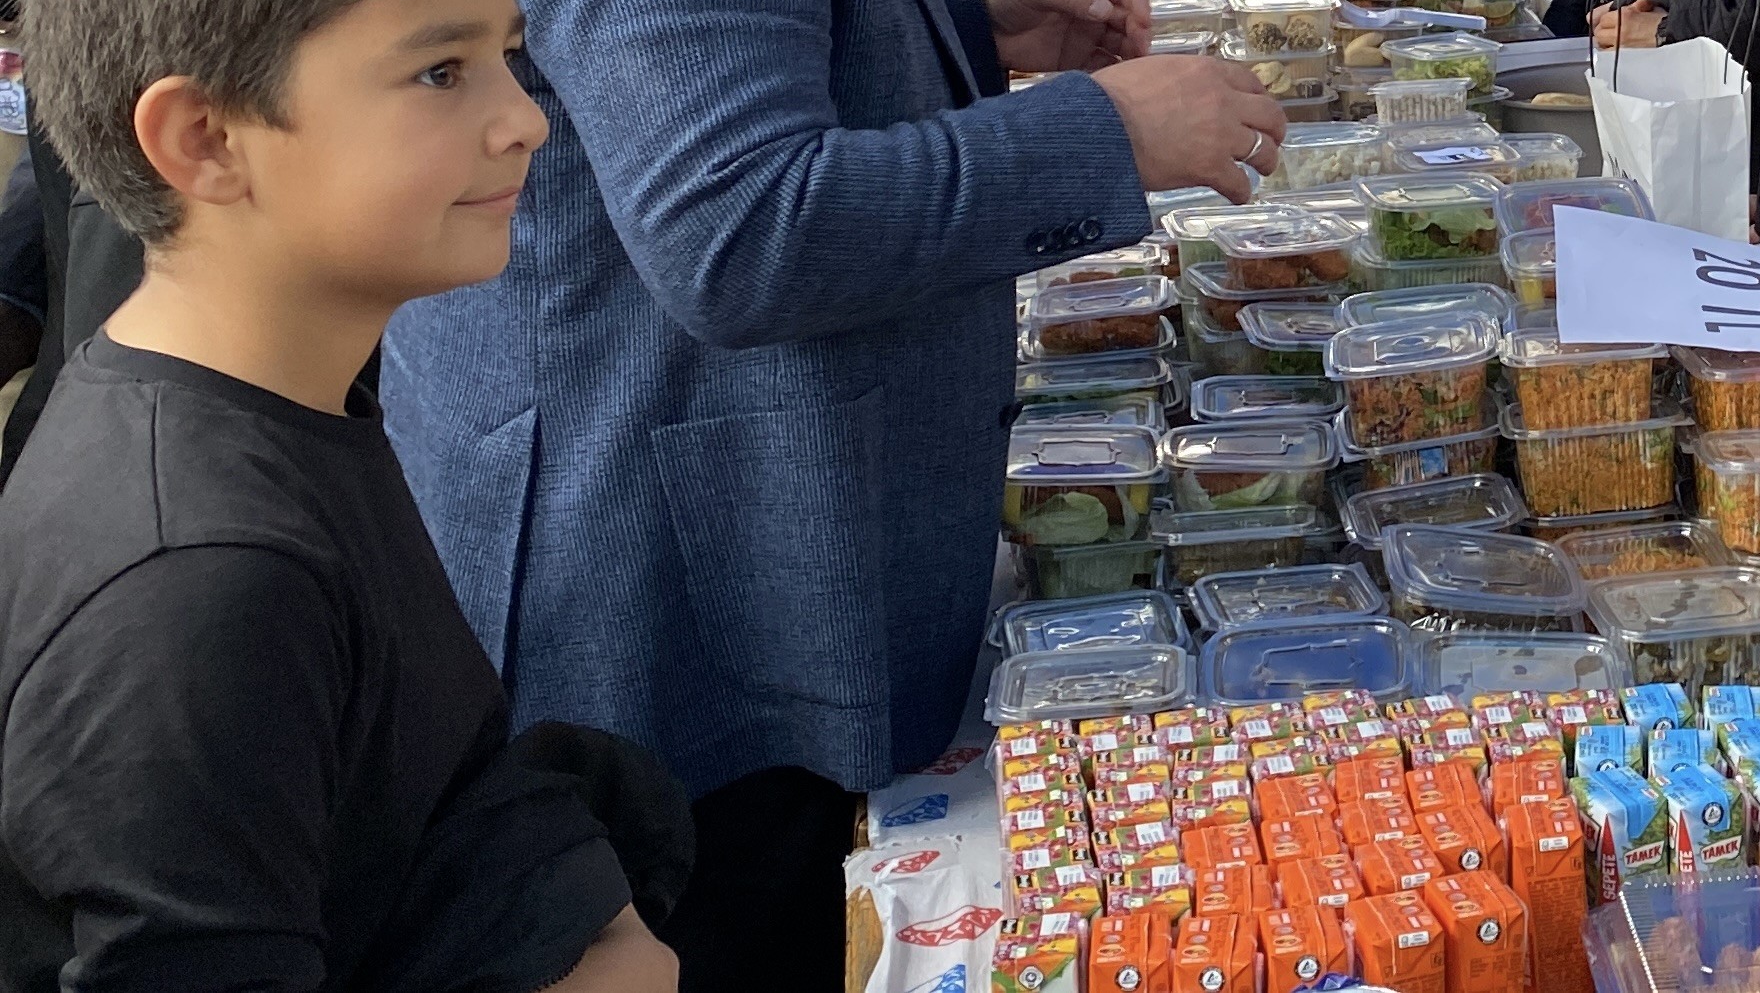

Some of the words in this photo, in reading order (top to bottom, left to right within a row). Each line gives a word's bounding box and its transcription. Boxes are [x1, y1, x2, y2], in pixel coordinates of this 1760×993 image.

[1625, 845, 1662, 866] TAMEK
[1701, 839, 1740, 860] TAMEK
[1602, 853, 1617, 901] SEPETE
